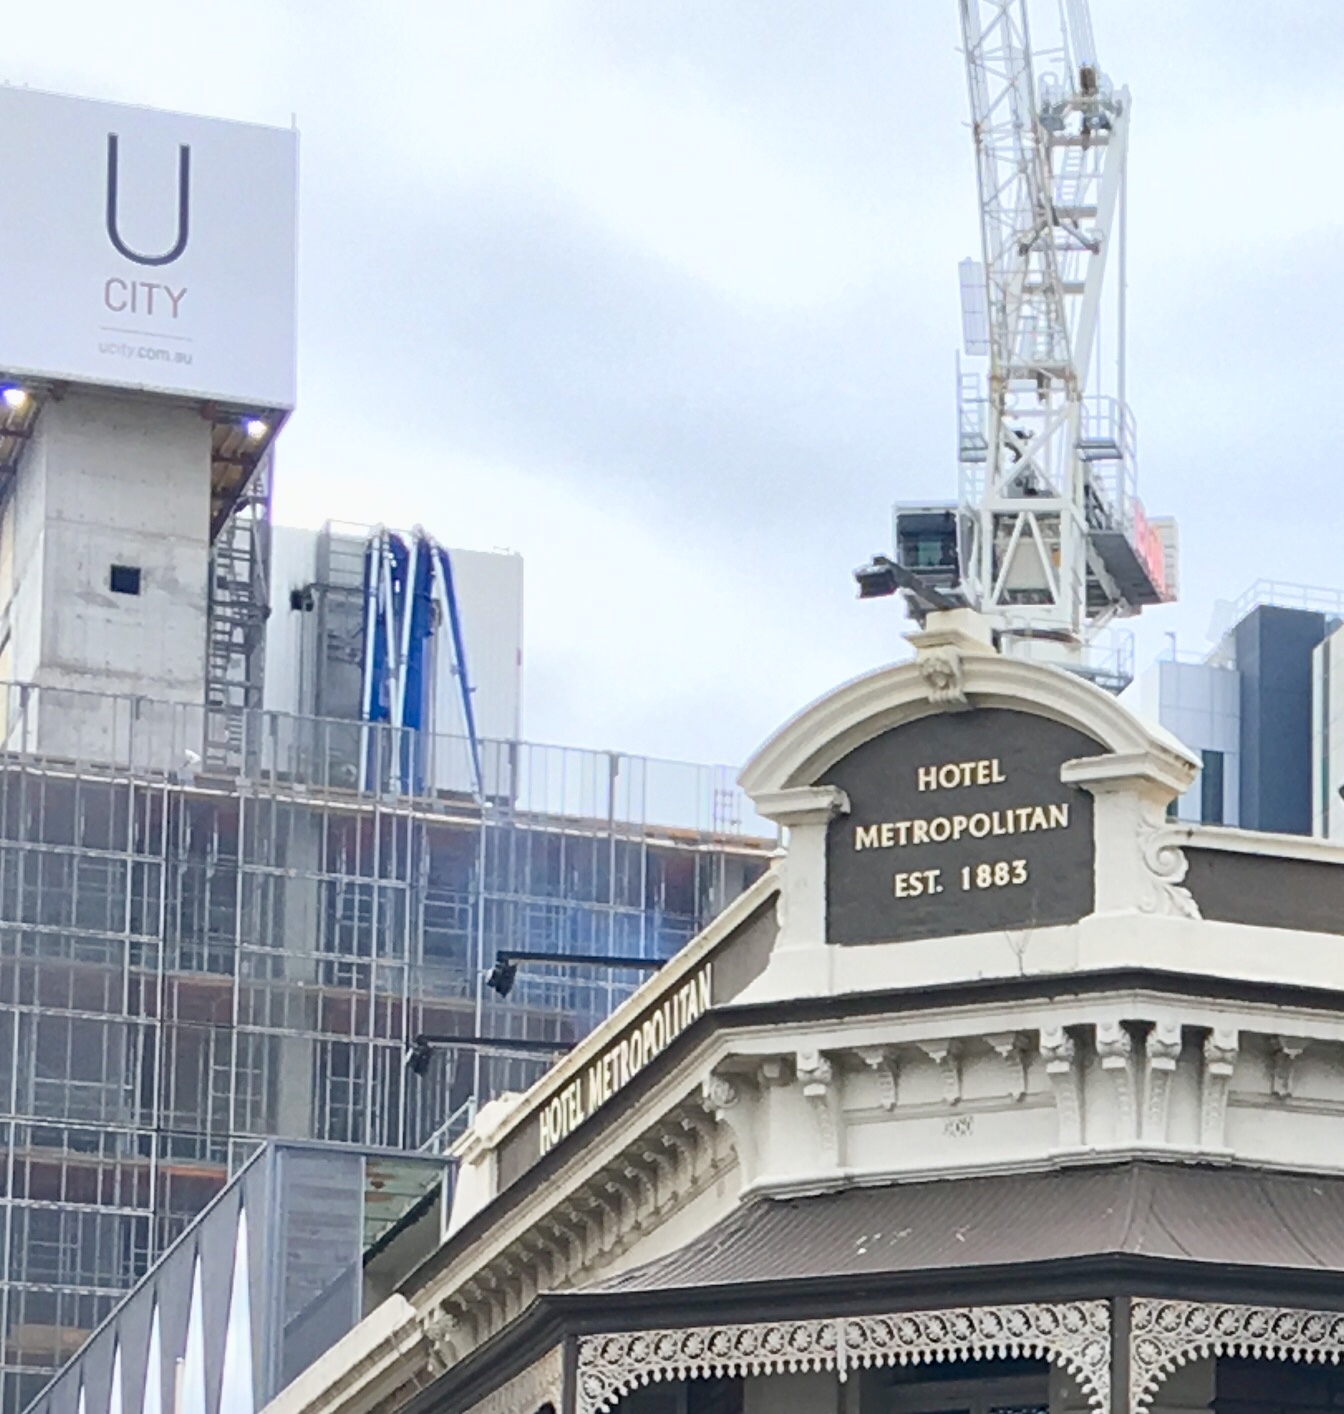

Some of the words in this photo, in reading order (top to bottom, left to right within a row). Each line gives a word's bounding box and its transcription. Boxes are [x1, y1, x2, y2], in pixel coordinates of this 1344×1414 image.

[106, 132, 191, 267] U
[104, 277, 188, 319] CITY
[99, 343, 193, 365] ucity.com.au
[918, 759, 1006, 791] HOTEL
[855, 803, 1069, 850] METROPOLITAN
[895, 869, 943, 898] EST.
[961, 859, 1028, 891] 1883
[540, 1078, 584, 1157] HOTEL
[588, 962, 712, 1116] METROPOLITAN
